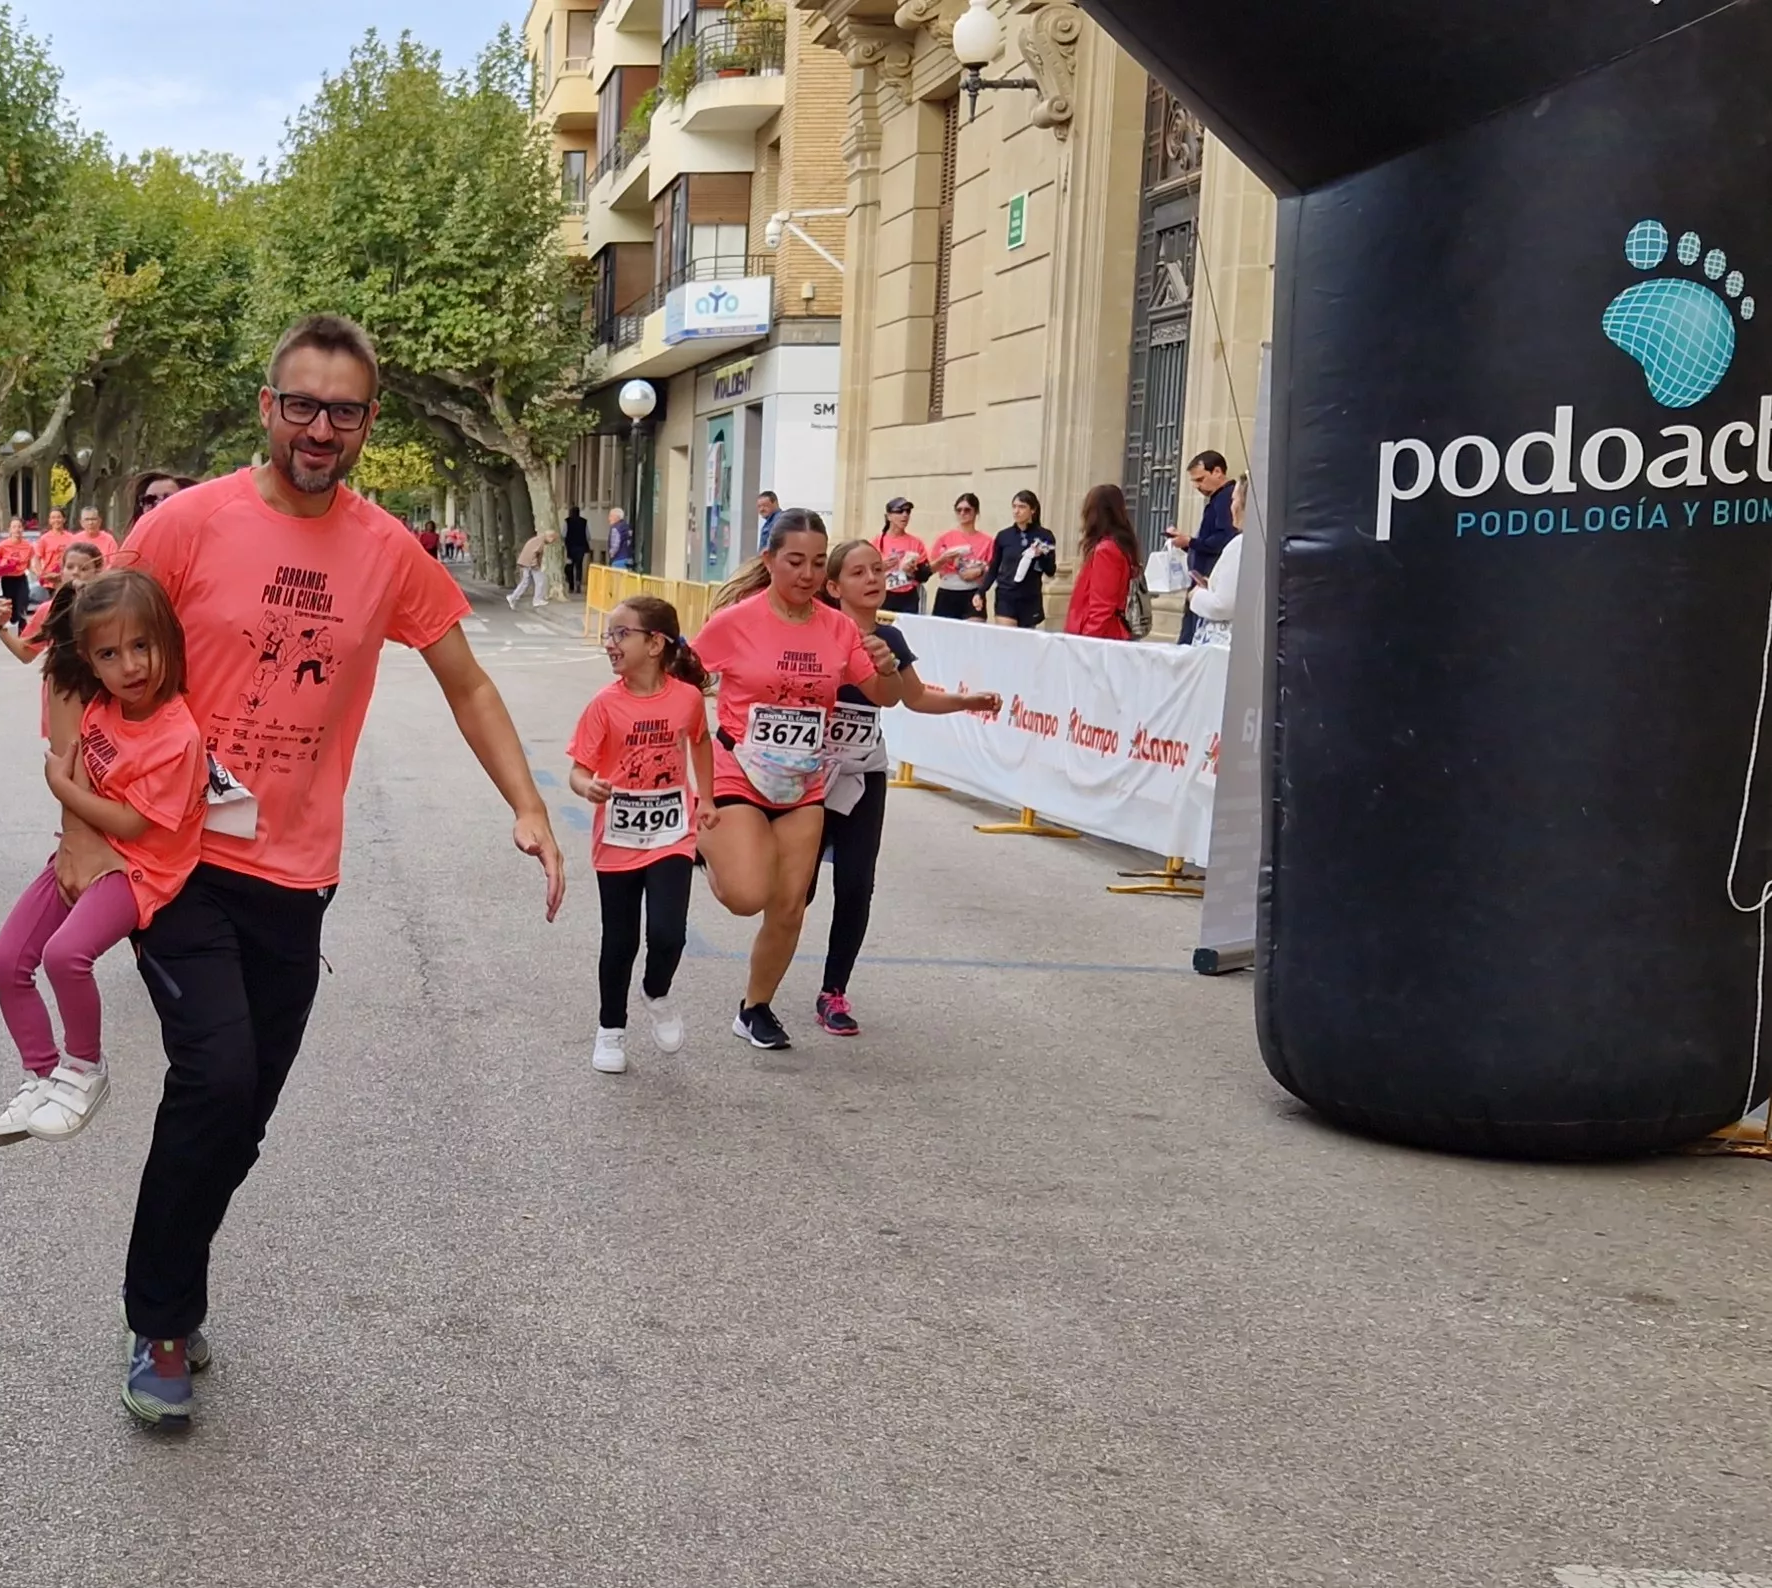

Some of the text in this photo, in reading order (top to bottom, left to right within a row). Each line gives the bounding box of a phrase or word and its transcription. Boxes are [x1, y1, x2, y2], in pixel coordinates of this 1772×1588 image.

[813, 403, 838, 416] SM
[1456, 496, 1669, 537] PODOLOGÍA
[1683, 501, 1701, 527] Y
[261, 584, 333, 613] POR LA CIENCIA
[1008, 693, 1059, 741] Alcampo
[754, 721, 816, 747] 3674
[1066, 706, 1119, 758] Alcampo
[614, 808, 679, 832] 3490
